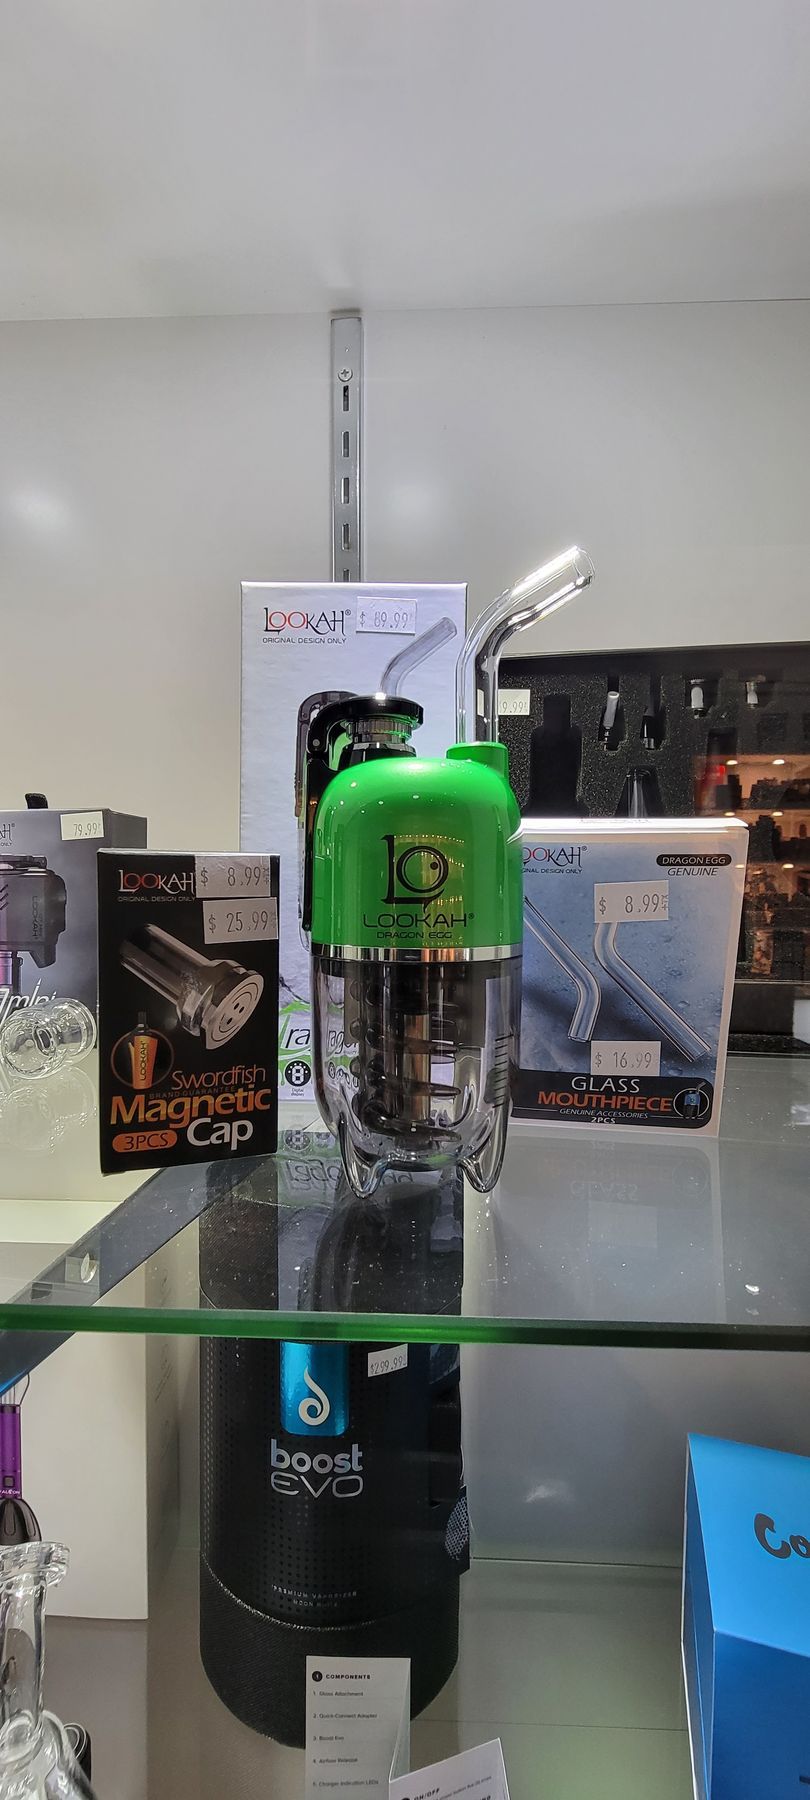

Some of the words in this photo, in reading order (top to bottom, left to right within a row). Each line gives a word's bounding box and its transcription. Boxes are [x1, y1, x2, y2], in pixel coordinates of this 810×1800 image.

[327, 637, 347, 645] ONLY
[662, 856, 704, 865] DRAGON
[705, 856, 726, 865] EGG
[200, 867, 209, 886] $
[227, 866, 262, 887] 8.99
[667, 867, 719, 876] GENUINE
[598, 896, 607, 915] $
[624, 893, 660, 914] 8.99
[208, 914, 217, 933] $
[226, 910, 270, 932] 25.99
[376, 931, 424, 939] DRAGON
[428, 931, 452, 939] EGG
[594, 1054, 603, 1068] $
[613, 1051, 653, 1069] 16.99
[171, 1064, 266, 1091] Swordfish
[571, 1076, 641, 1093] GLASS
[110, 1083, 272, 1129] Magnetic
[537, 1090, 673, 1112] MOUTHPIECE
[559, 1108, 596, 1116] GENUINE
[596, 1110, 649, 1119] ACCESSORIES
[590, 1116, 616, 1124] 2PCS
[123, 1132, 169, 1151] 3PCS
[186, 1117, 254, 1150] Cap
[270, 1438, 364, 1474] boost
[270, 1471, 364, 1499] EVO
